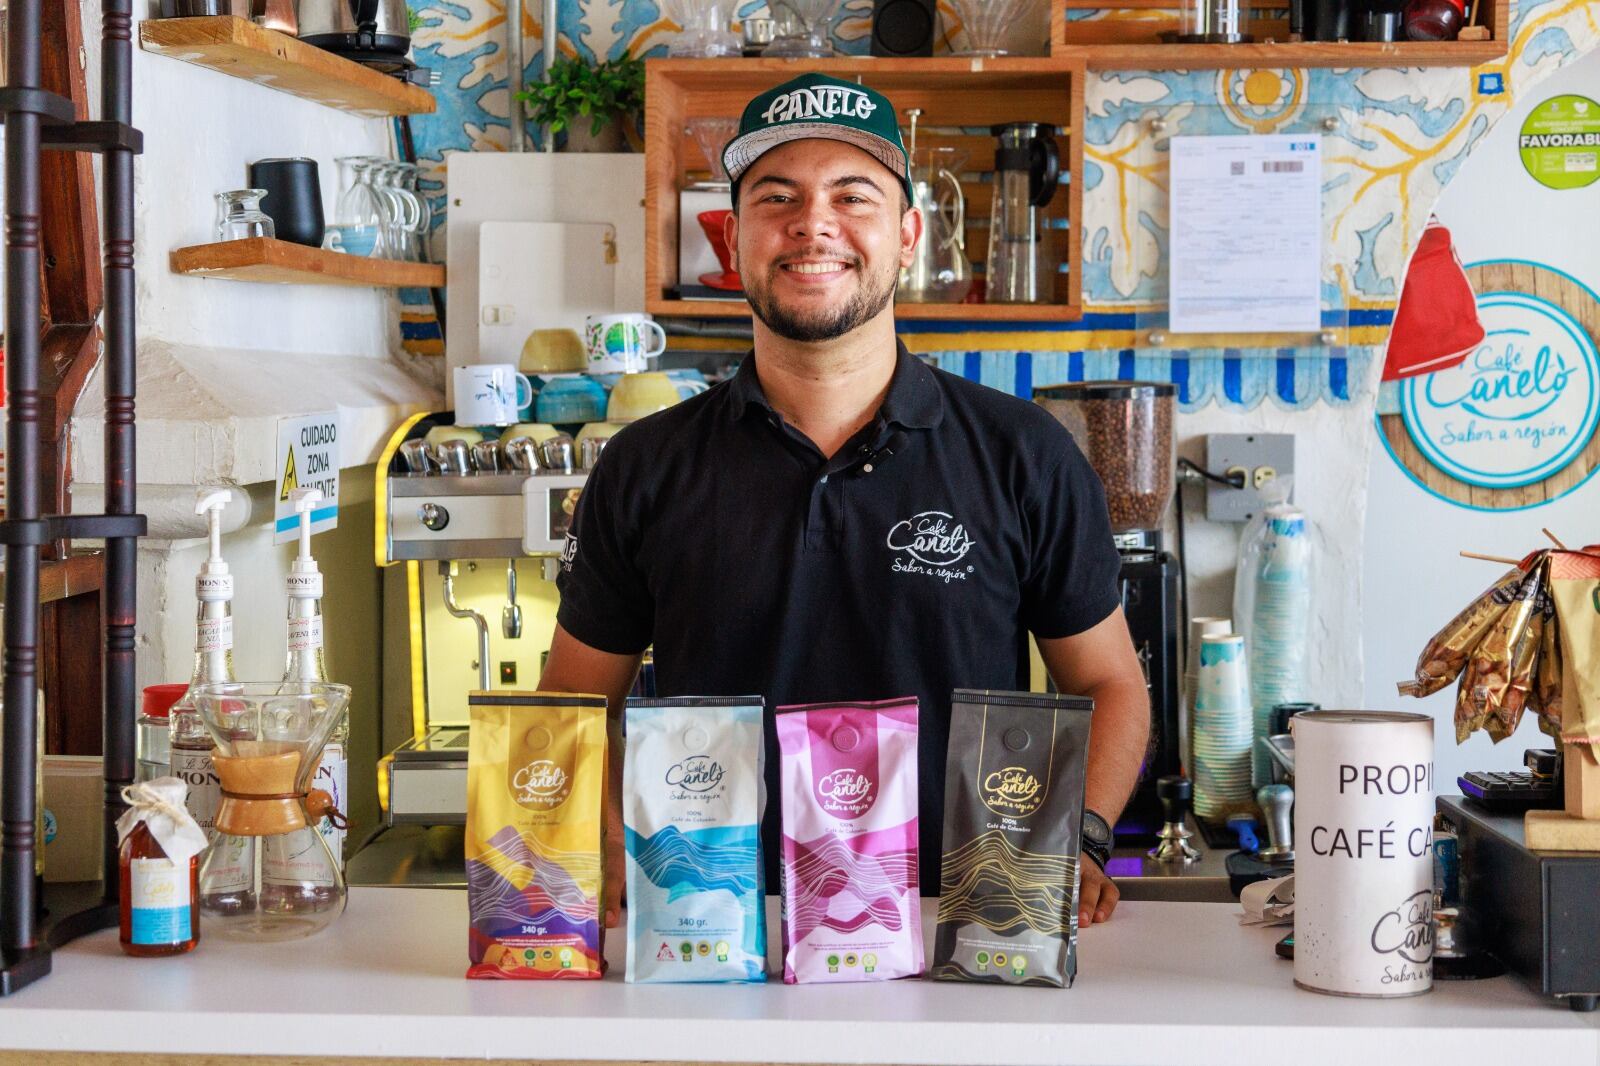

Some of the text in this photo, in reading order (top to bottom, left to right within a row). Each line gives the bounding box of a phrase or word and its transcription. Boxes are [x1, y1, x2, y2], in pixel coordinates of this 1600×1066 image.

[1475, 343, 1522, 372] Café
[301, 424, 337, 447] CUIDADO
[1440, 420, 1568, 448] Sabor a región
[307, 451, 330, 475] ZONA
[917, 518, 948, 536] Café
[892, 557, 966, 584] Sabor a región
[176, 771, 220, 786] MON
[1311, 821, 1396, 859] CAFÉ
[537, 927, 547, 935] gr.
[679, 918, 708, 928] 340 gr.
[1381, 964, 1417, 984] Sabor
